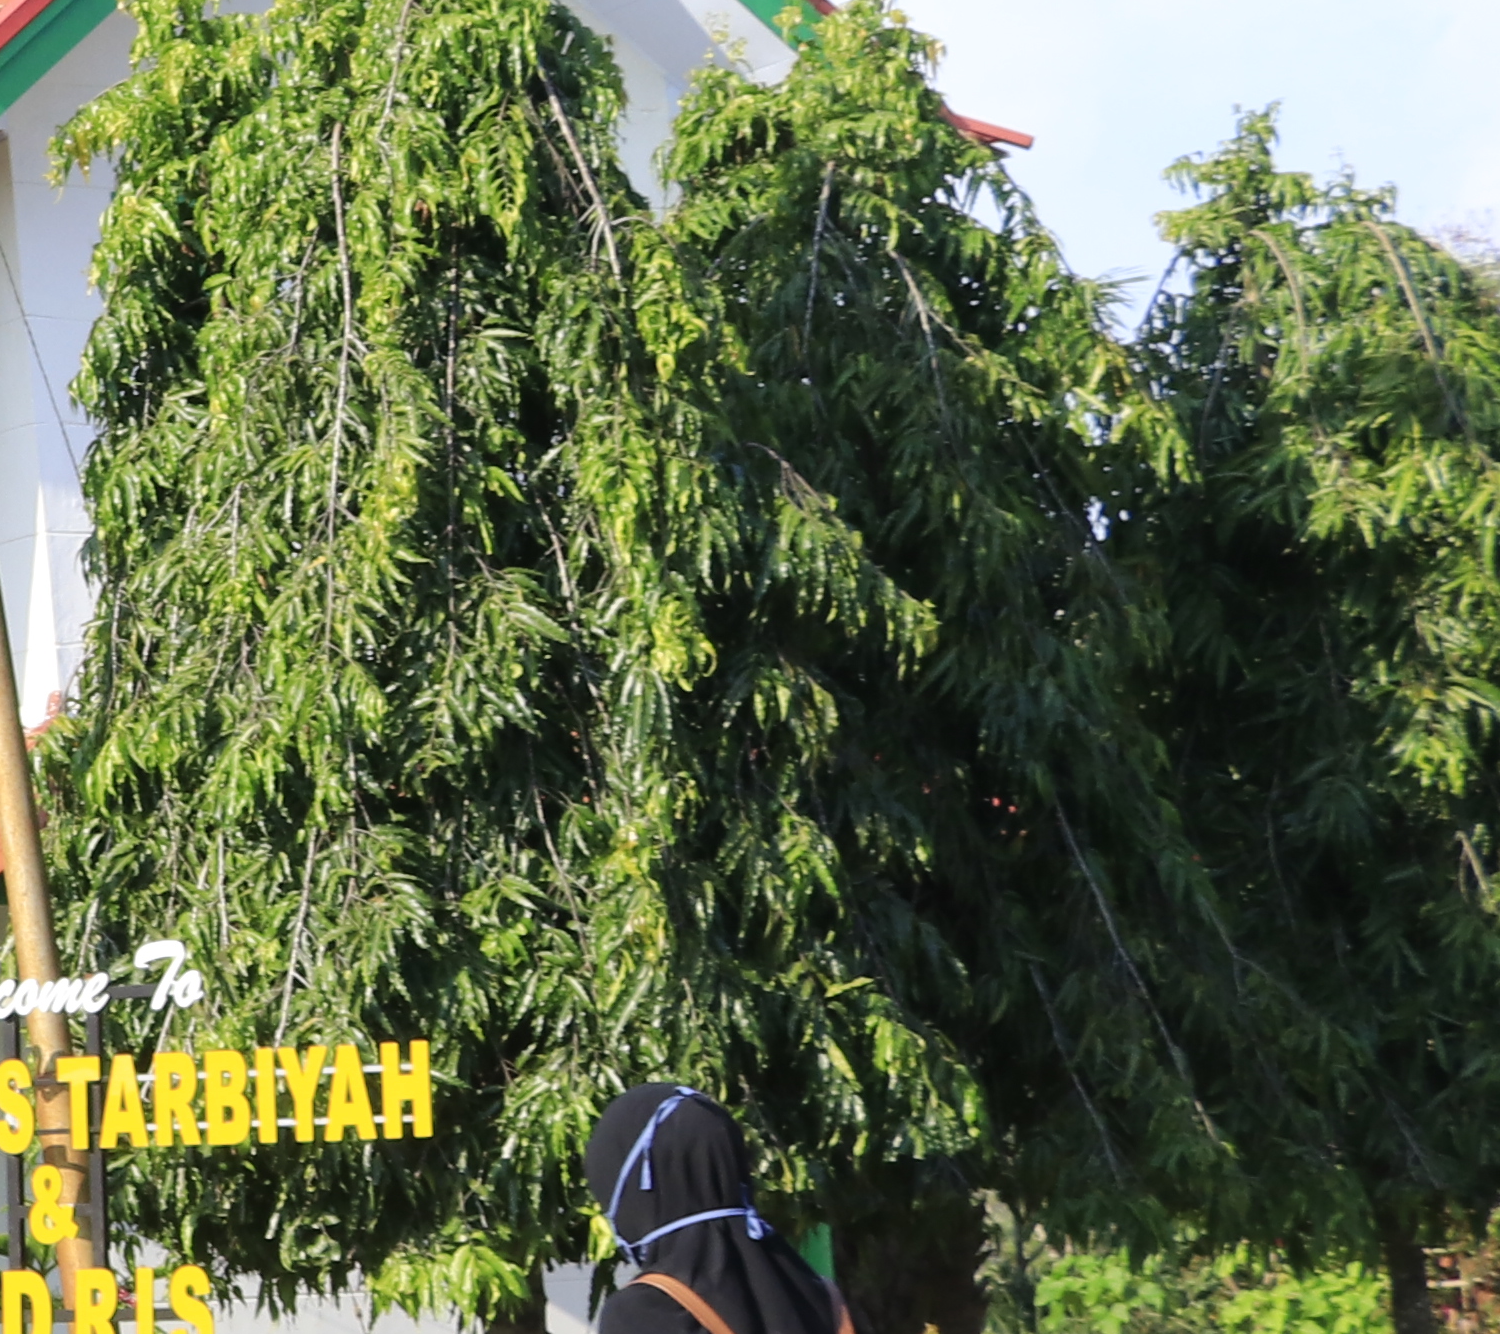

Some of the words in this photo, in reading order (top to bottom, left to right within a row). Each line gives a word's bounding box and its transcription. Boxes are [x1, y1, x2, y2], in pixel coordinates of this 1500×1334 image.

[135, 940, 205, 1012] To
[56, 1040, 434, 1151] TARBIYAH
[28, 1165, 78, 1245] &
